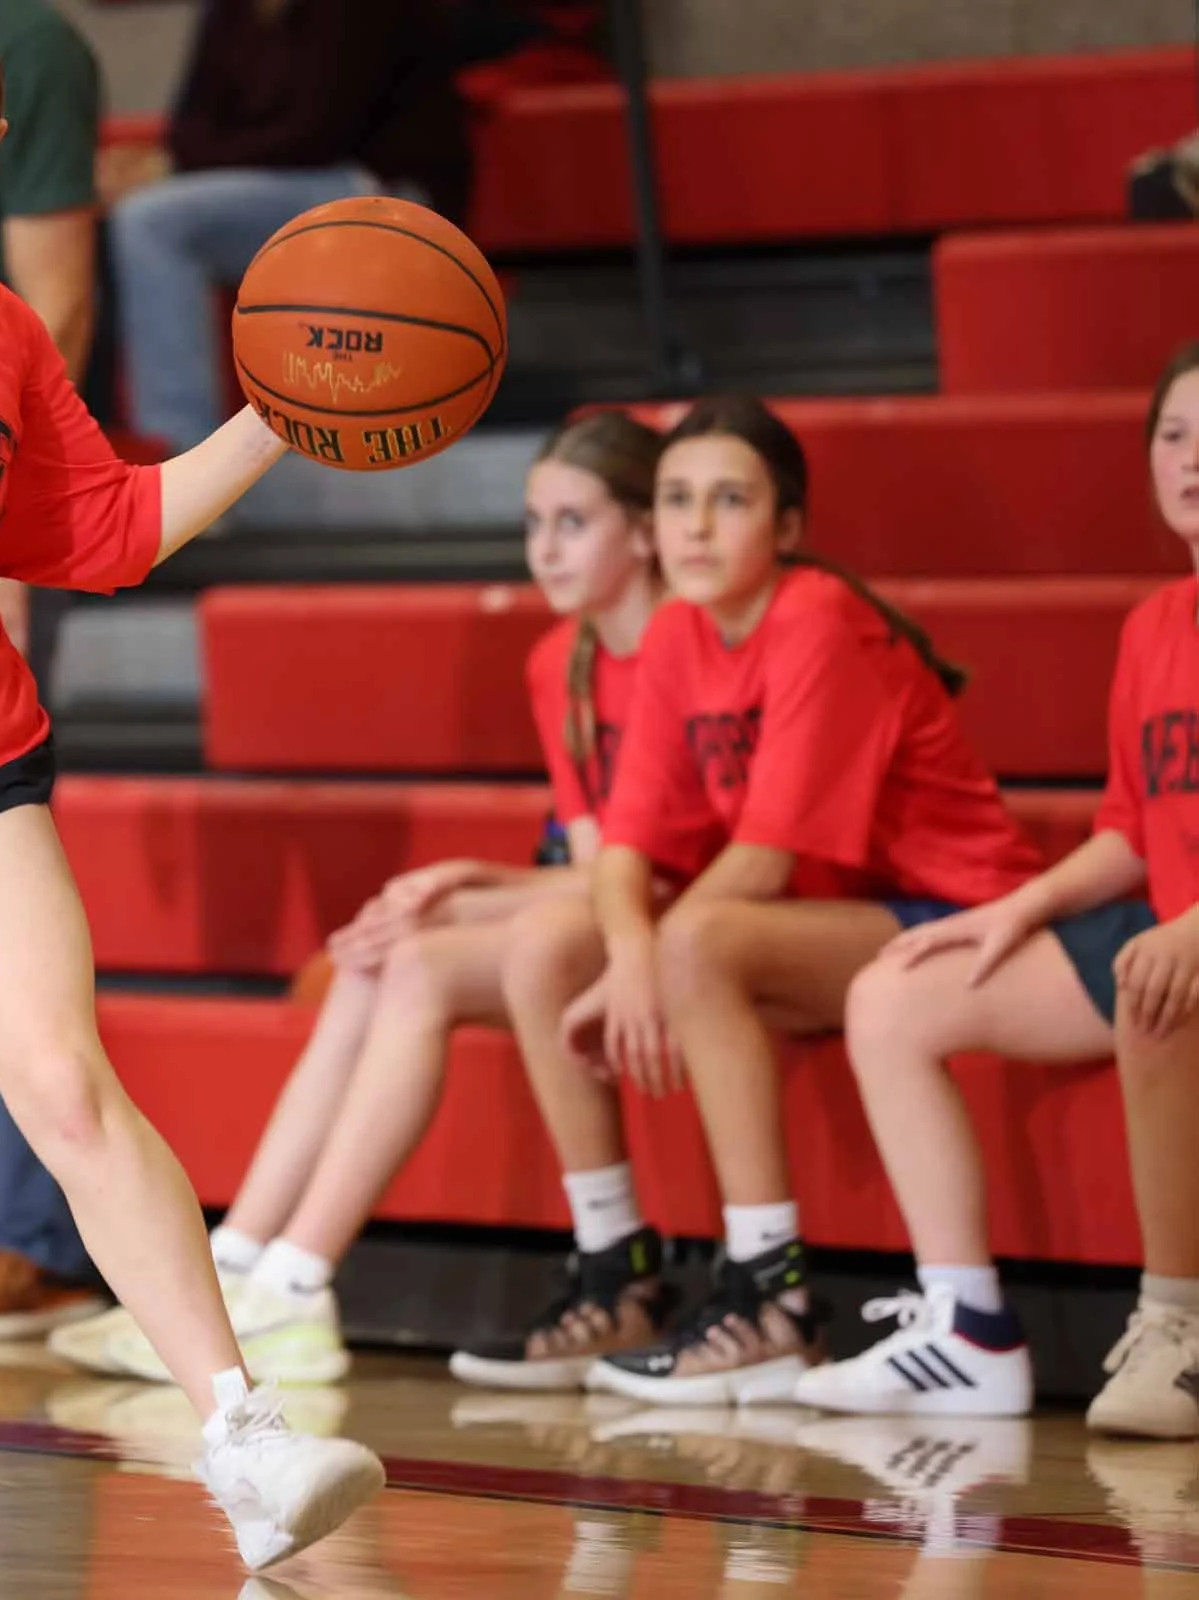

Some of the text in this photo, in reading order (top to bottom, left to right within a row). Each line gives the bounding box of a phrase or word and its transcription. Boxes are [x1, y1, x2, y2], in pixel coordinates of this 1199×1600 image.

[306, 326, 383, 353] ROCK
[252, 395, 450, 465] THE ROCK
